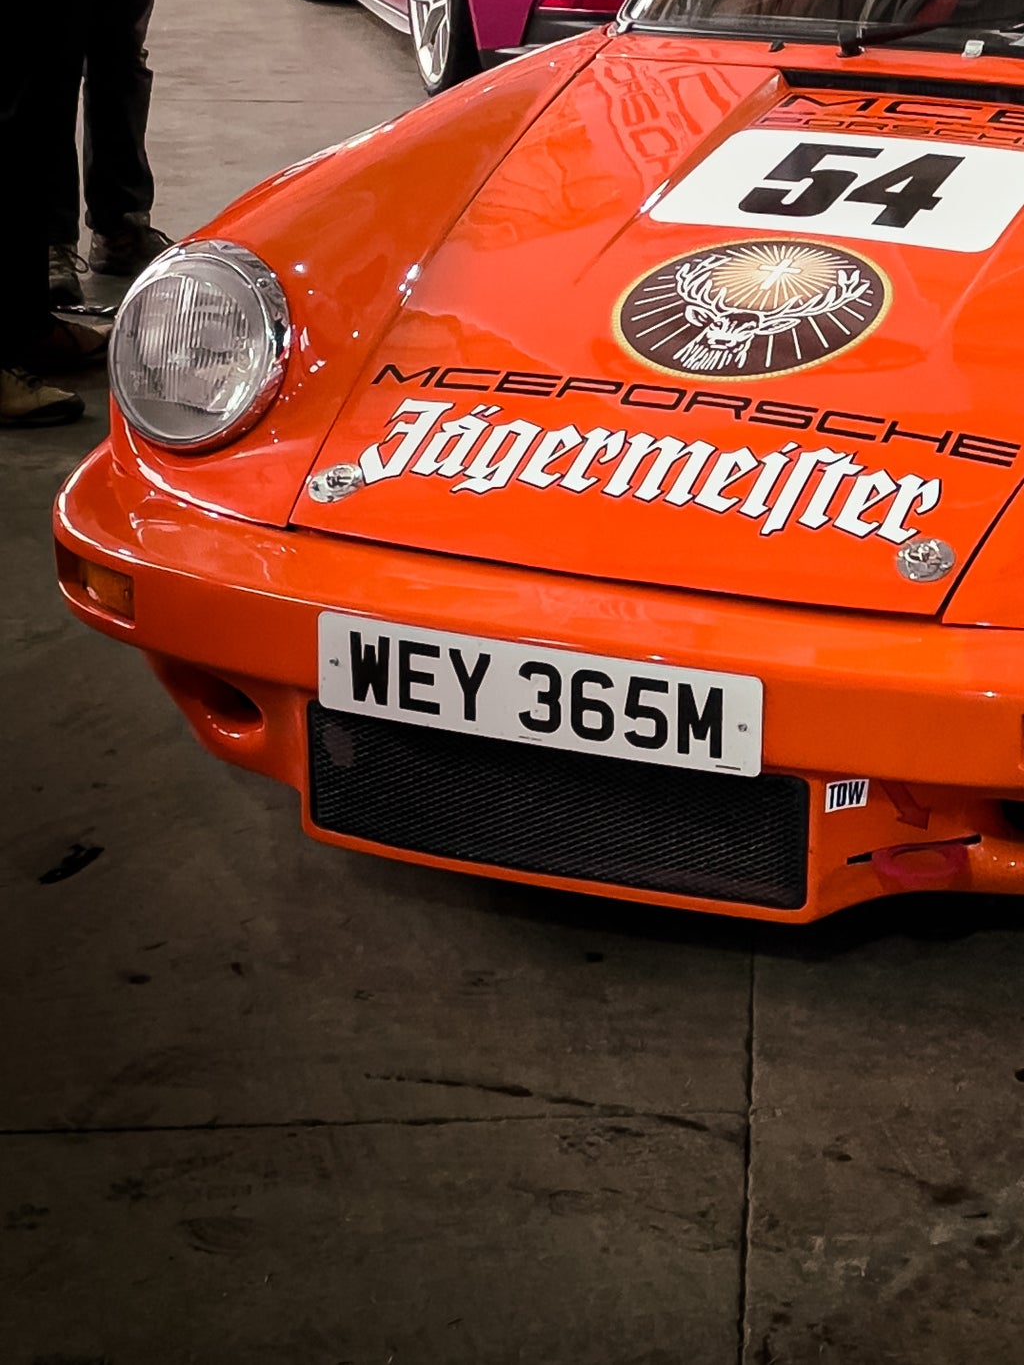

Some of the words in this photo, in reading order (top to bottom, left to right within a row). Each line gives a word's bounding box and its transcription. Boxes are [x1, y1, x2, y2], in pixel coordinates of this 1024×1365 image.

[738, 142, 966, 229] 54
[349, 630, 491, 721] WEY
[518, 661, 723, 759] 365M
[828, 781, 866, 811] TOW
